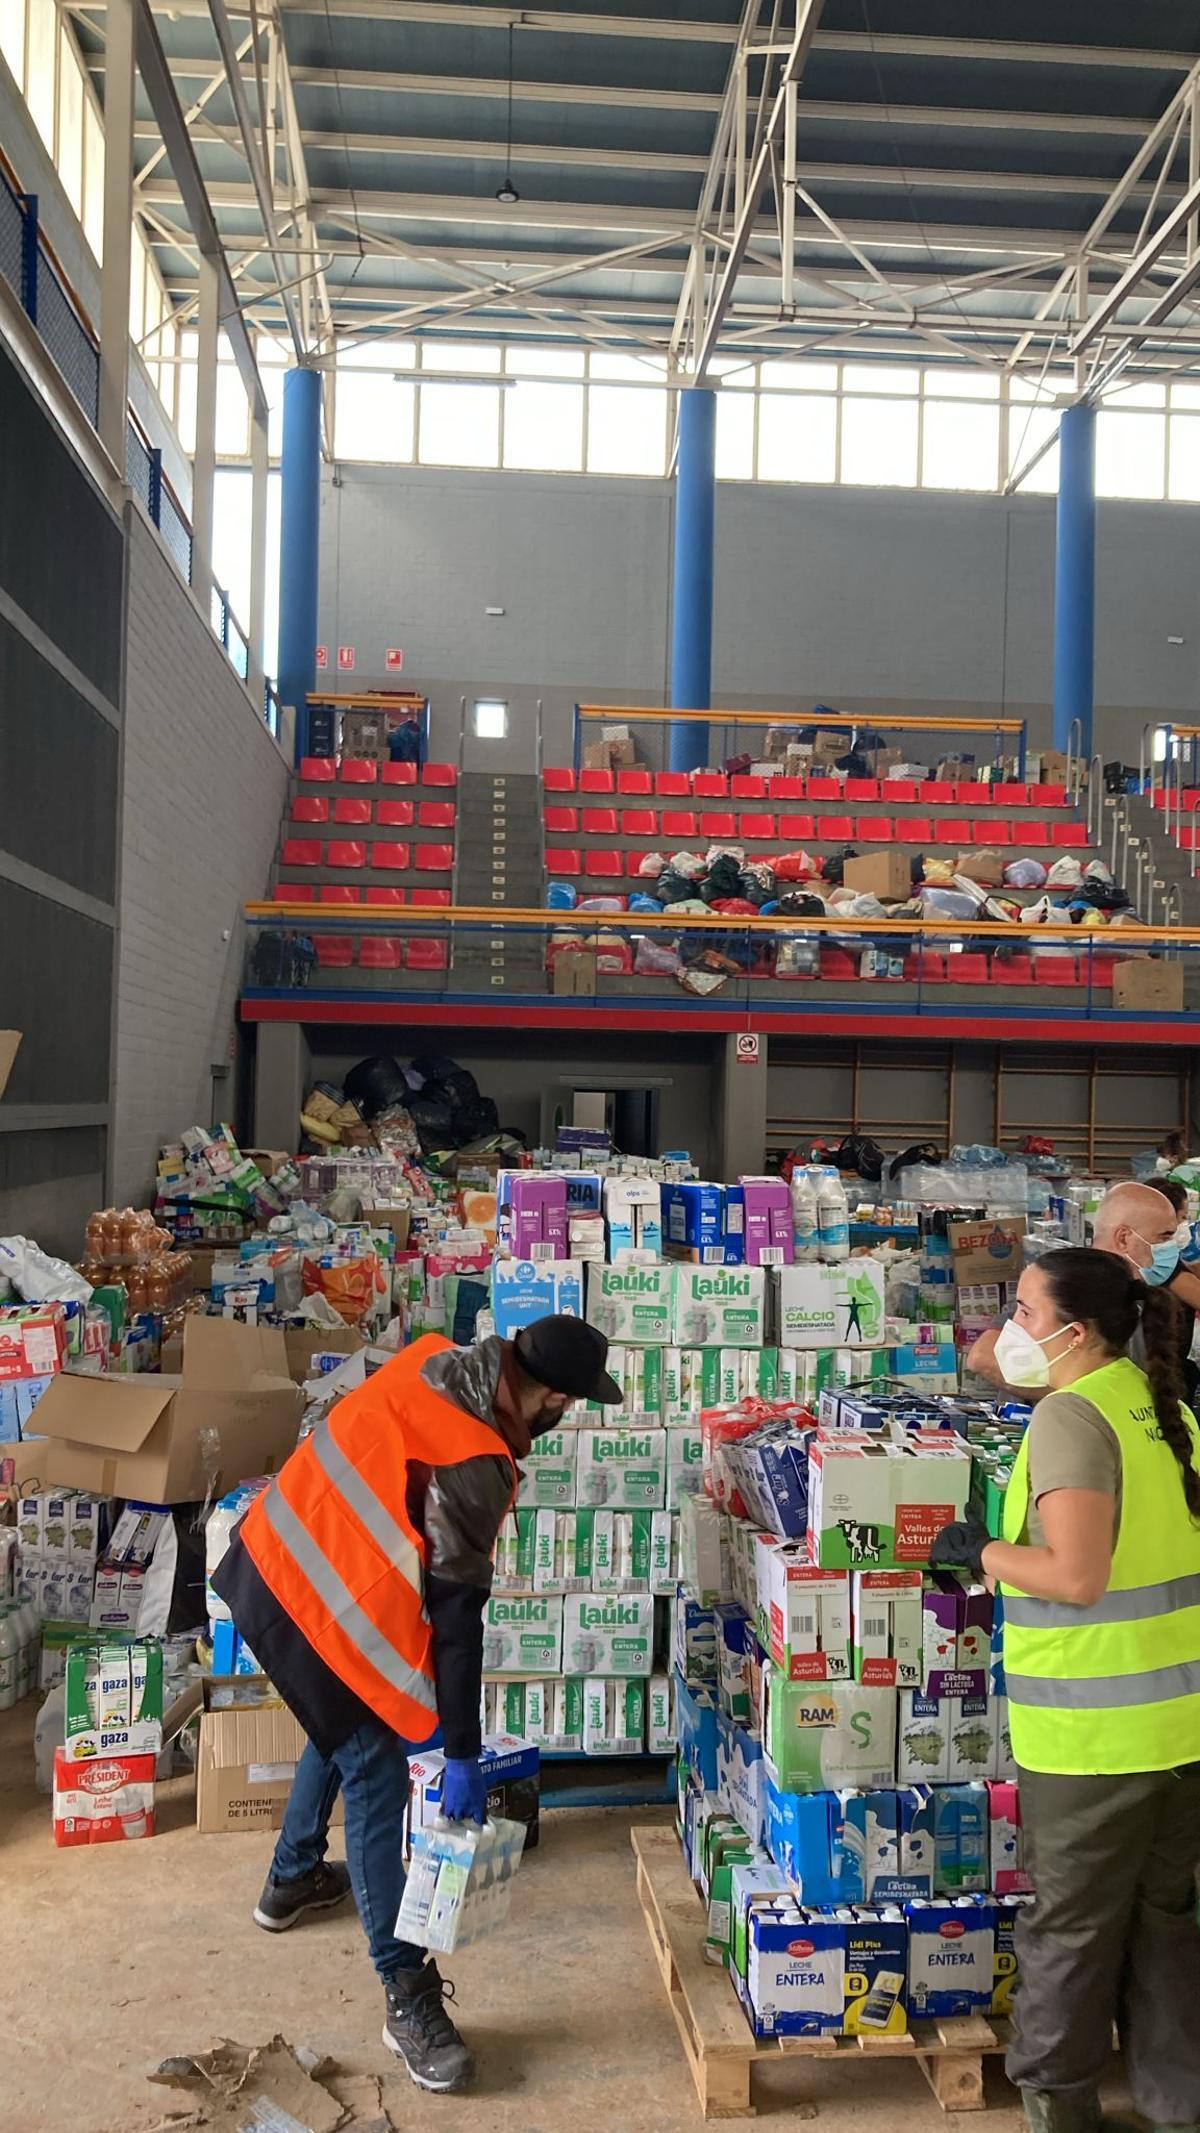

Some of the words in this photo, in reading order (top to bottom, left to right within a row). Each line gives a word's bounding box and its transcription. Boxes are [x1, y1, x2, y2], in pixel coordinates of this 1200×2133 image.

[566, 1184, 594, 1201] RIA
[786, 1311, 836, 1322] CALCIO
[530, 1434, 564, 1456] uki
[904, 1524, 932, 1533] Valles
[897, 1533, 938, 1545] Asturi
[793, 1667, 823, 1676] Asturias
[863, 1671, 893, 1680] Asturias
[102, 1678, 128, 1693] gaza
[800, 1708, 834, 1722] RAM
[101, 1732, 129, 1748] gaza
[410, 1762, 426, 1777] Río
[492, 1755, 522, 1770] FAMILIAR
[228, 1809, 241, 1817] DE
[928, 1952, 976, 1967] ENTERA
[775, 1972, 825, 1986] ENTERA
